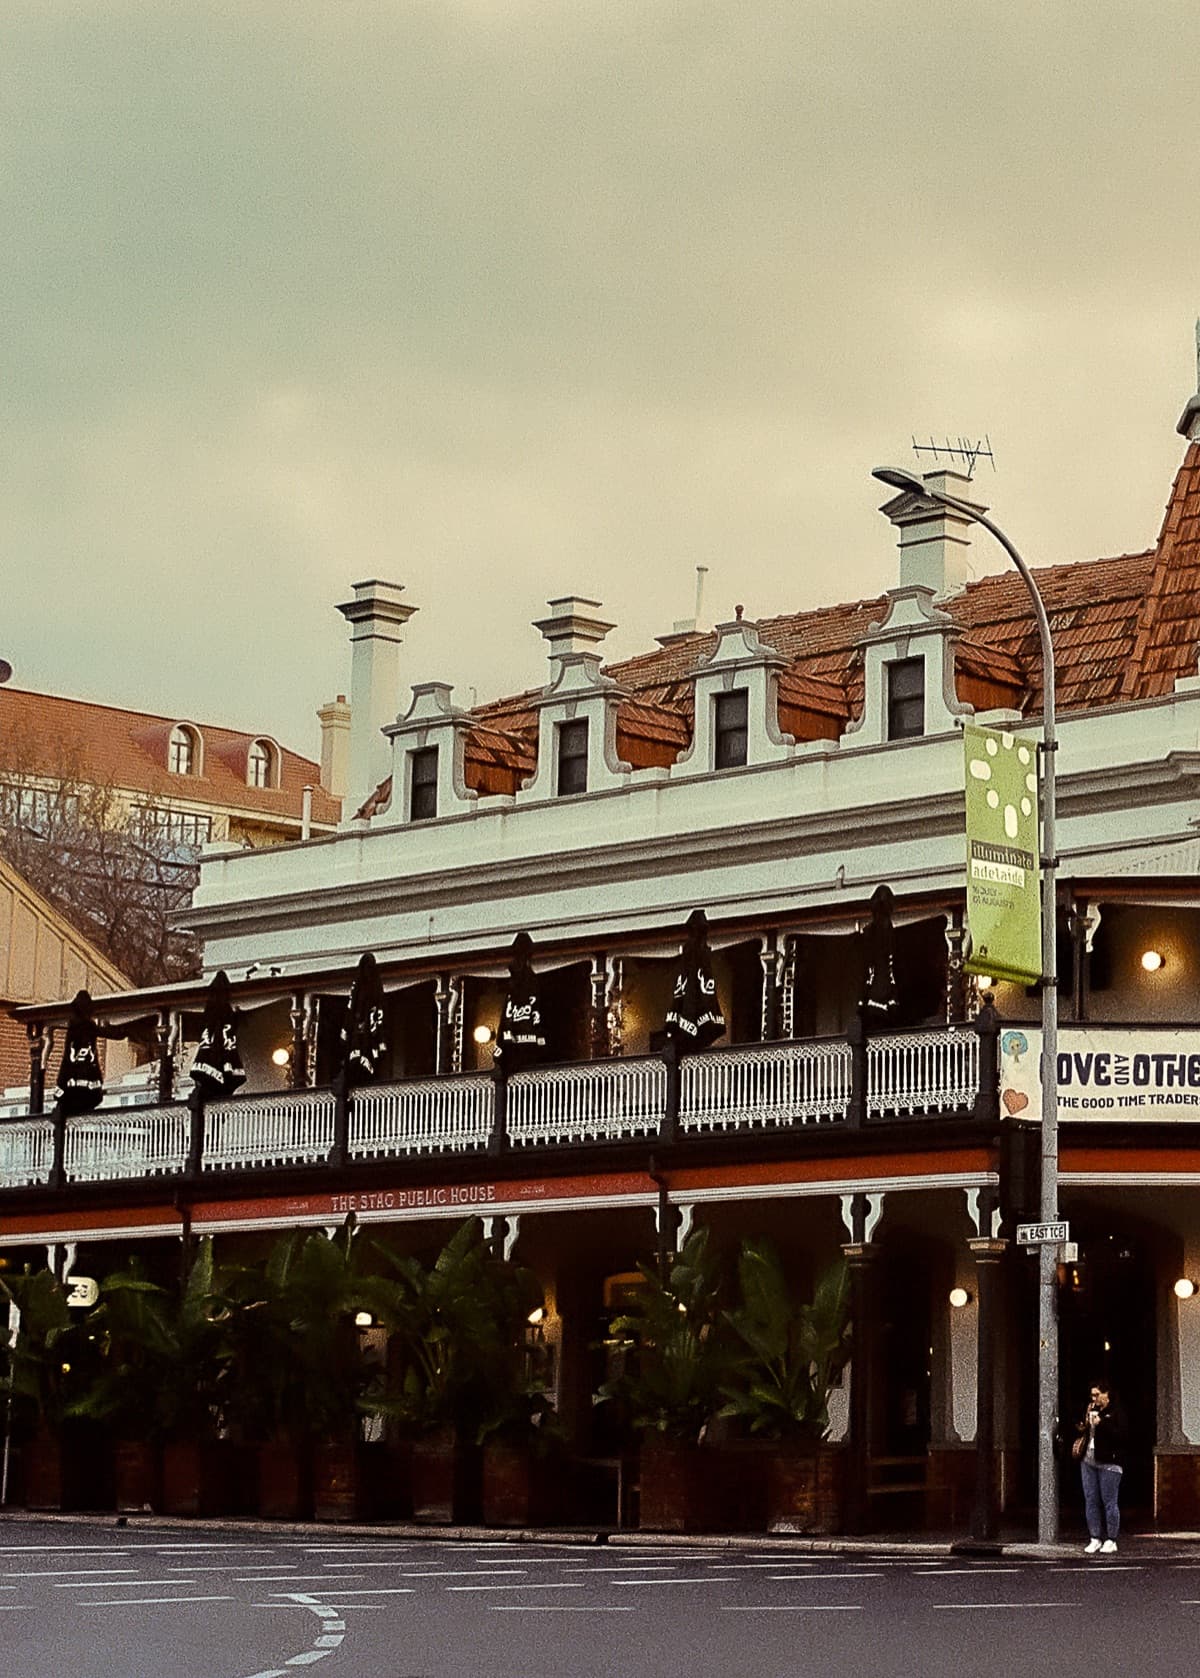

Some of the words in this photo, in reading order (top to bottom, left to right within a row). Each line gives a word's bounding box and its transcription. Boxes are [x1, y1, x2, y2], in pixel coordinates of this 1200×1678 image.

[973, 842, 1032, 868] illuminate
[973, 866, 1024, 885] adelaide
[1040, 1052, 1111, 1086] OVE
[1114, 1054, 1129, 1085] AND
[1057, 1096, 1079, 1108] THE
[1081, 1097, 1114, 1108] GOOD
[1117, 1095, 1146, 1107] TIME
[330, 1195, 356, 1211] THE
[399, 1188, 446, 1206] PUBLIC
[450, 1185, 495, 1204] HOUSE
[1030, 1227, 1048, 1240] EAST
